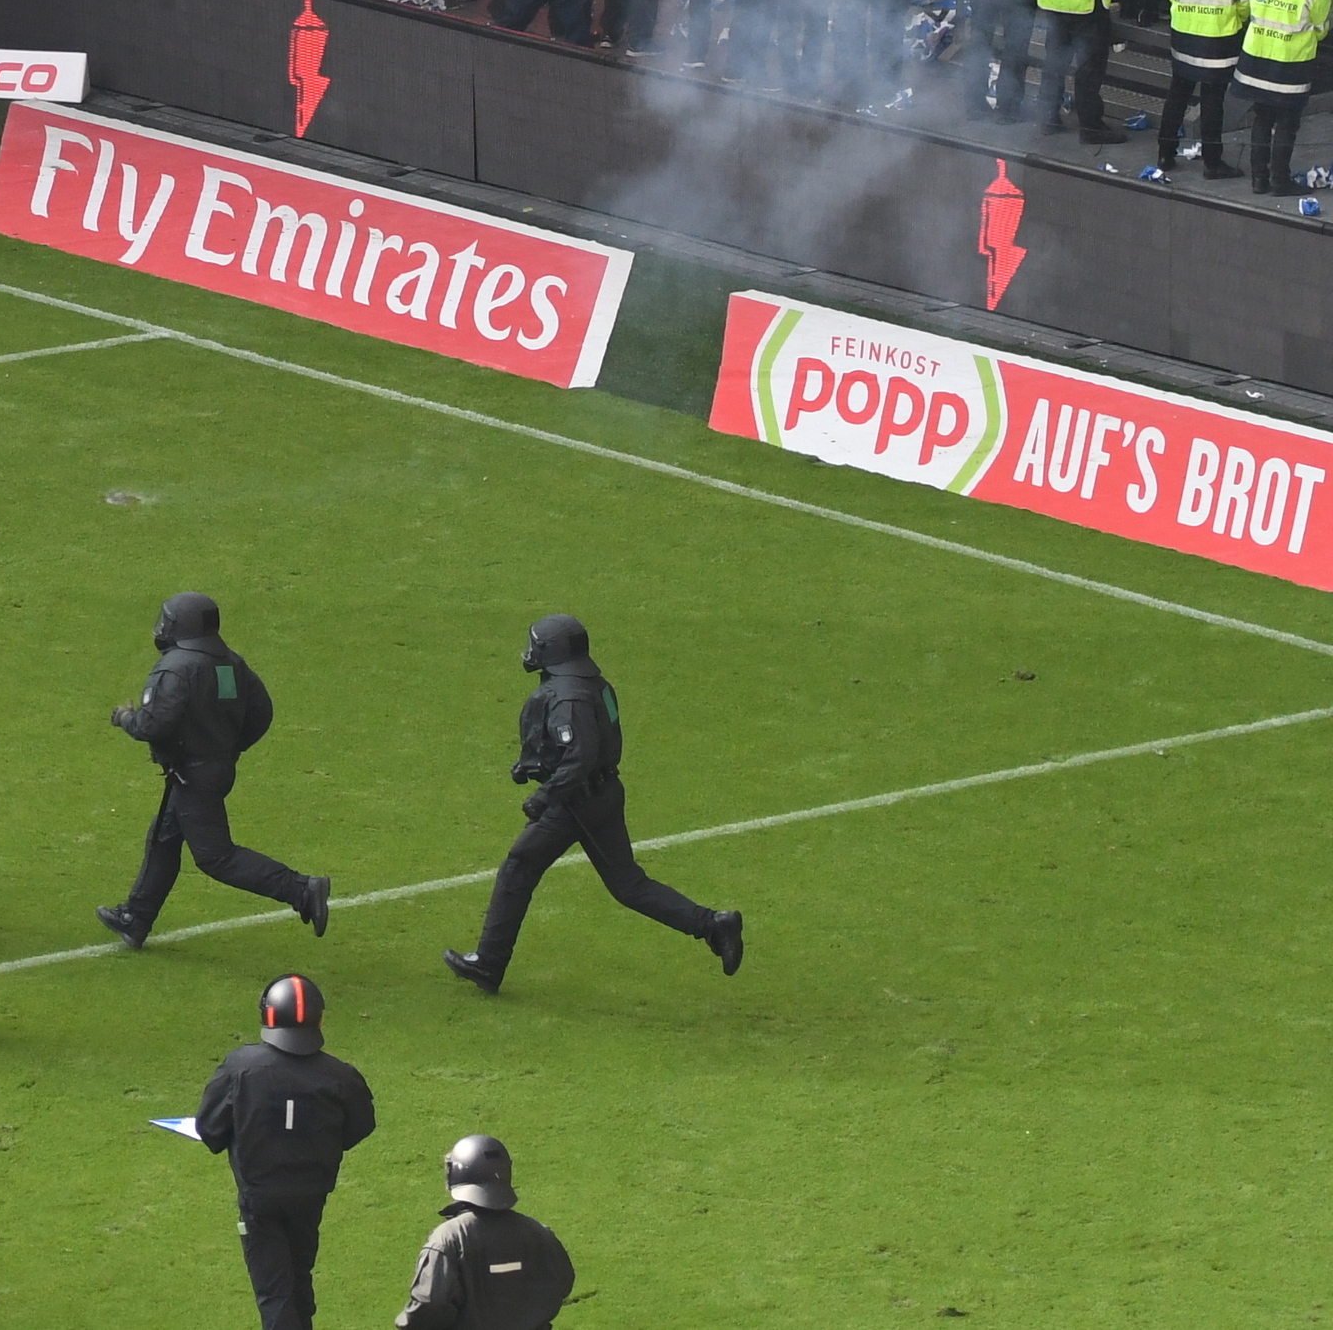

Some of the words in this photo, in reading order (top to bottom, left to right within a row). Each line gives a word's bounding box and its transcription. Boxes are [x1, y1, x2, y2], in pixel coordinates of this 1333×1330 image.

[1177, 5, 1197, 14] EVENT
[1197, 6, 1224, 15] SECURITY
[30, 124, 175, 266] Fly
[184, 164, 568, 350] Emirates
[830, 336, 941, 378] FEINKOST
[1013, 397, 1166, 514] AUF'S
[1176, 437, 1325, 554] BROT
